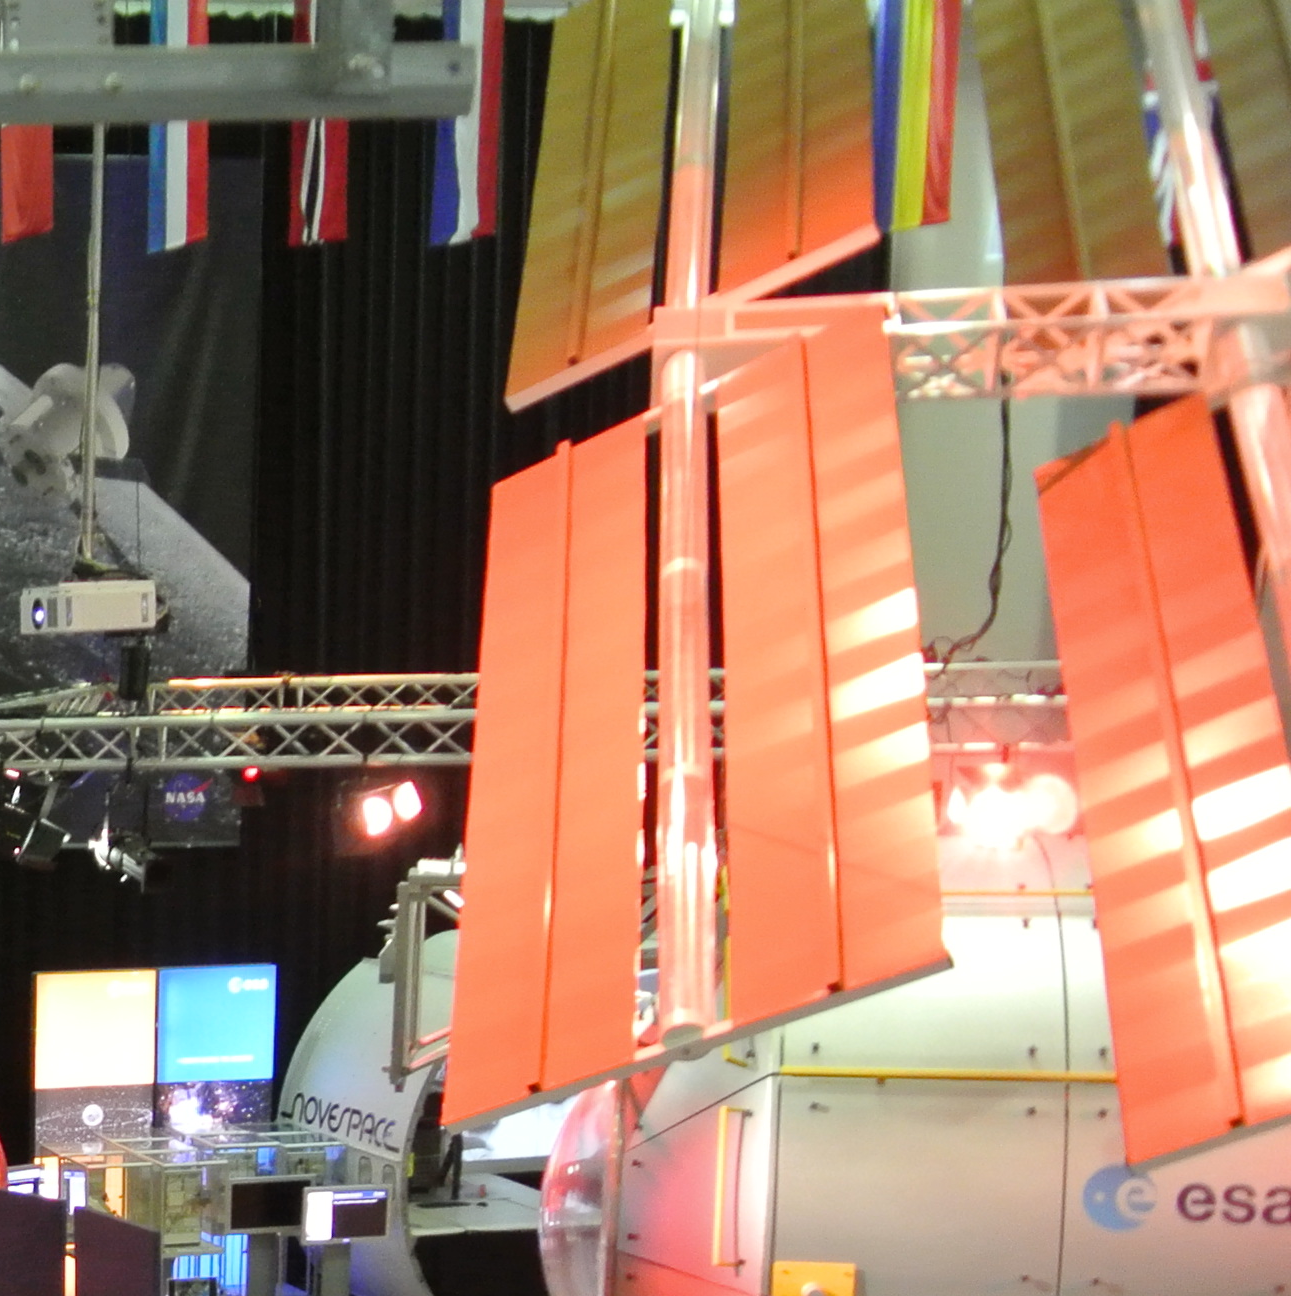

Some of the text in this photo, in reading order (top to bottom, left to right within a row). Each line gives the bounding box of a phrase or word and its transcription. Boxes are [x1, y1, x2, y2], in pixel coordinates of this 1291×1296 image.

[165, 790, 206, 804] NASA
[280, 1092, 400, 1154] NOVESPACE
[1176, 1182, 1291, 1226] esa
